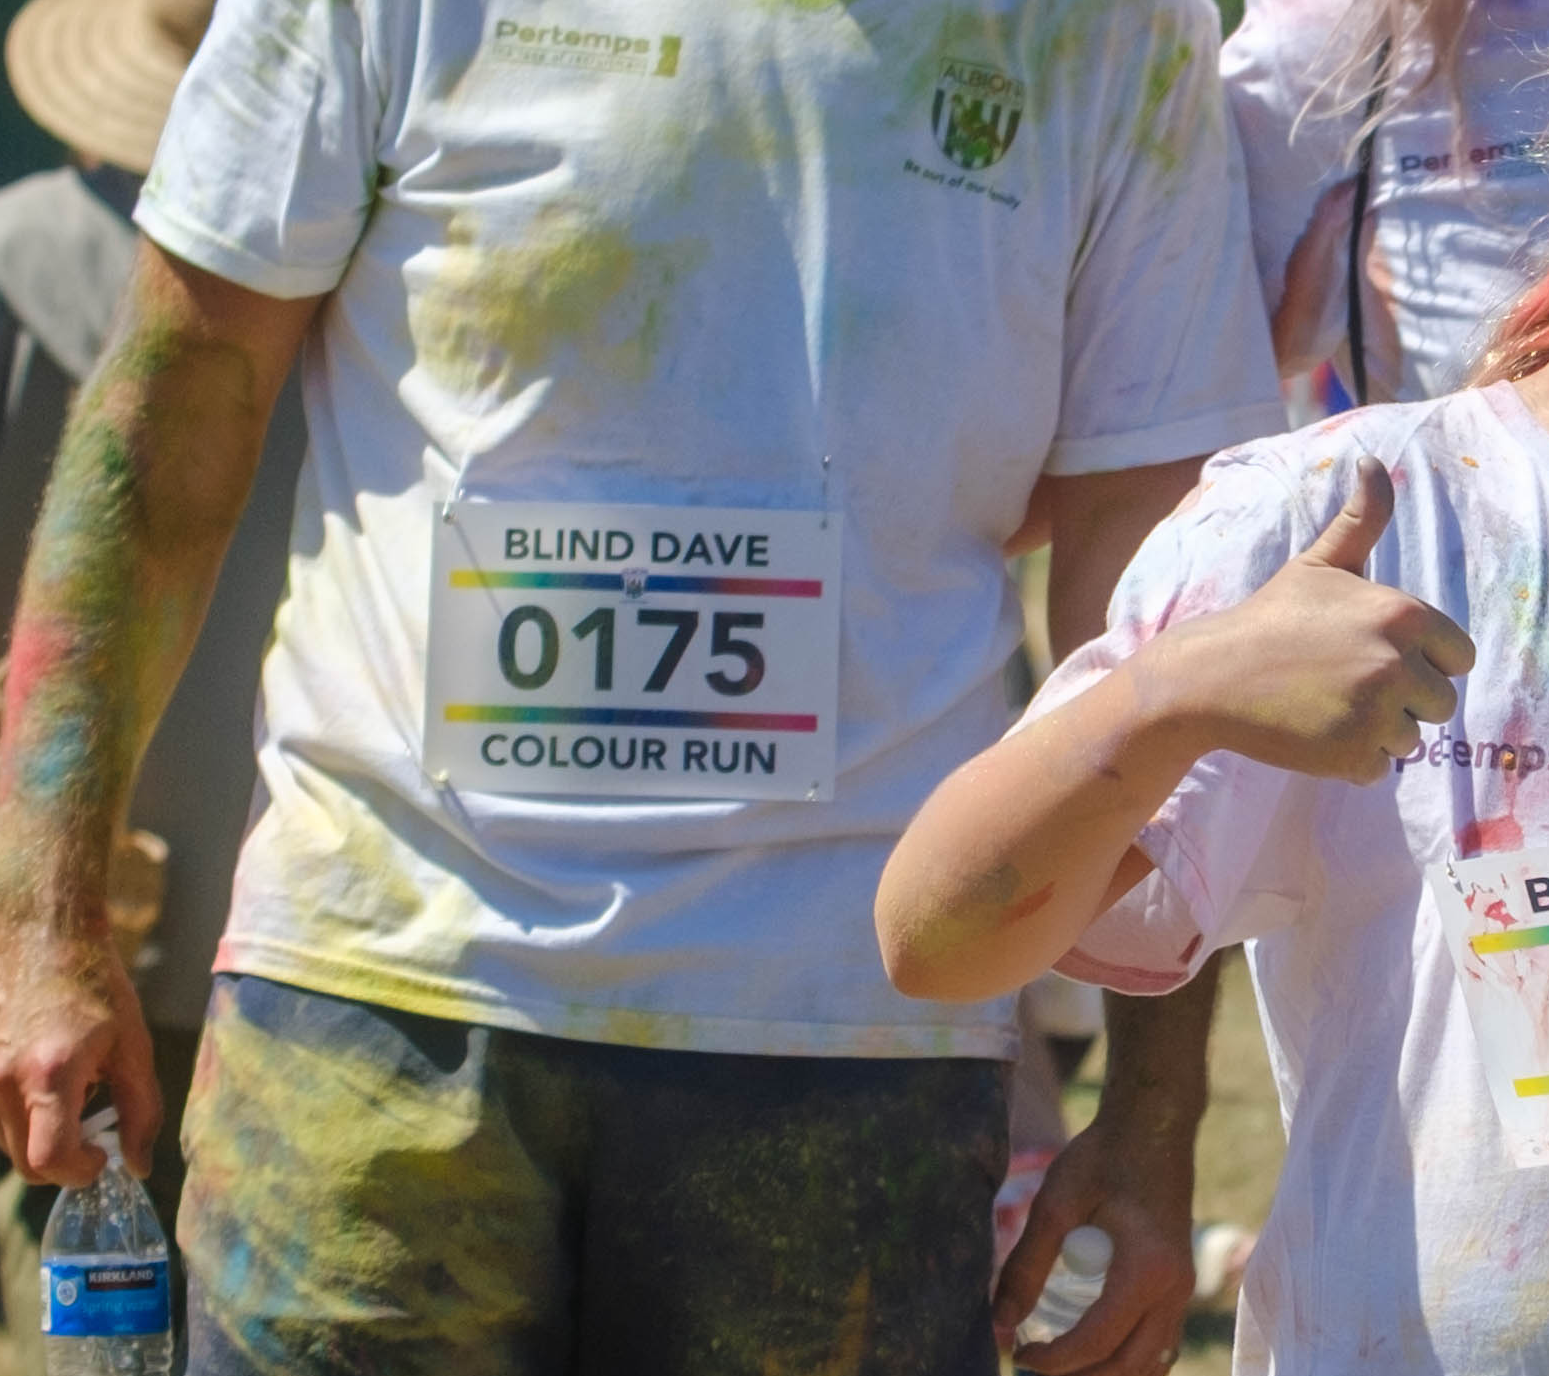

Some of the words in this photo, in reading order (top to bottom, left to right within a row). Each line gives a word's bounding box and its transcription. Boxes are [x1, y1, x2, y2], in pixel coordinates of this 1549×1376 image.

[496, 20, 651, 55] Pertemps
[504, 528, 635, 561] BLIND
[652, 532, 770, 567] DAVE
[497, 604, 766, 697] 0175
[481, 733, 667, 771] COLOUR
[683, 739, 776, 774] RUN
[89, 1269, 155, 1284] KIRKLAND
